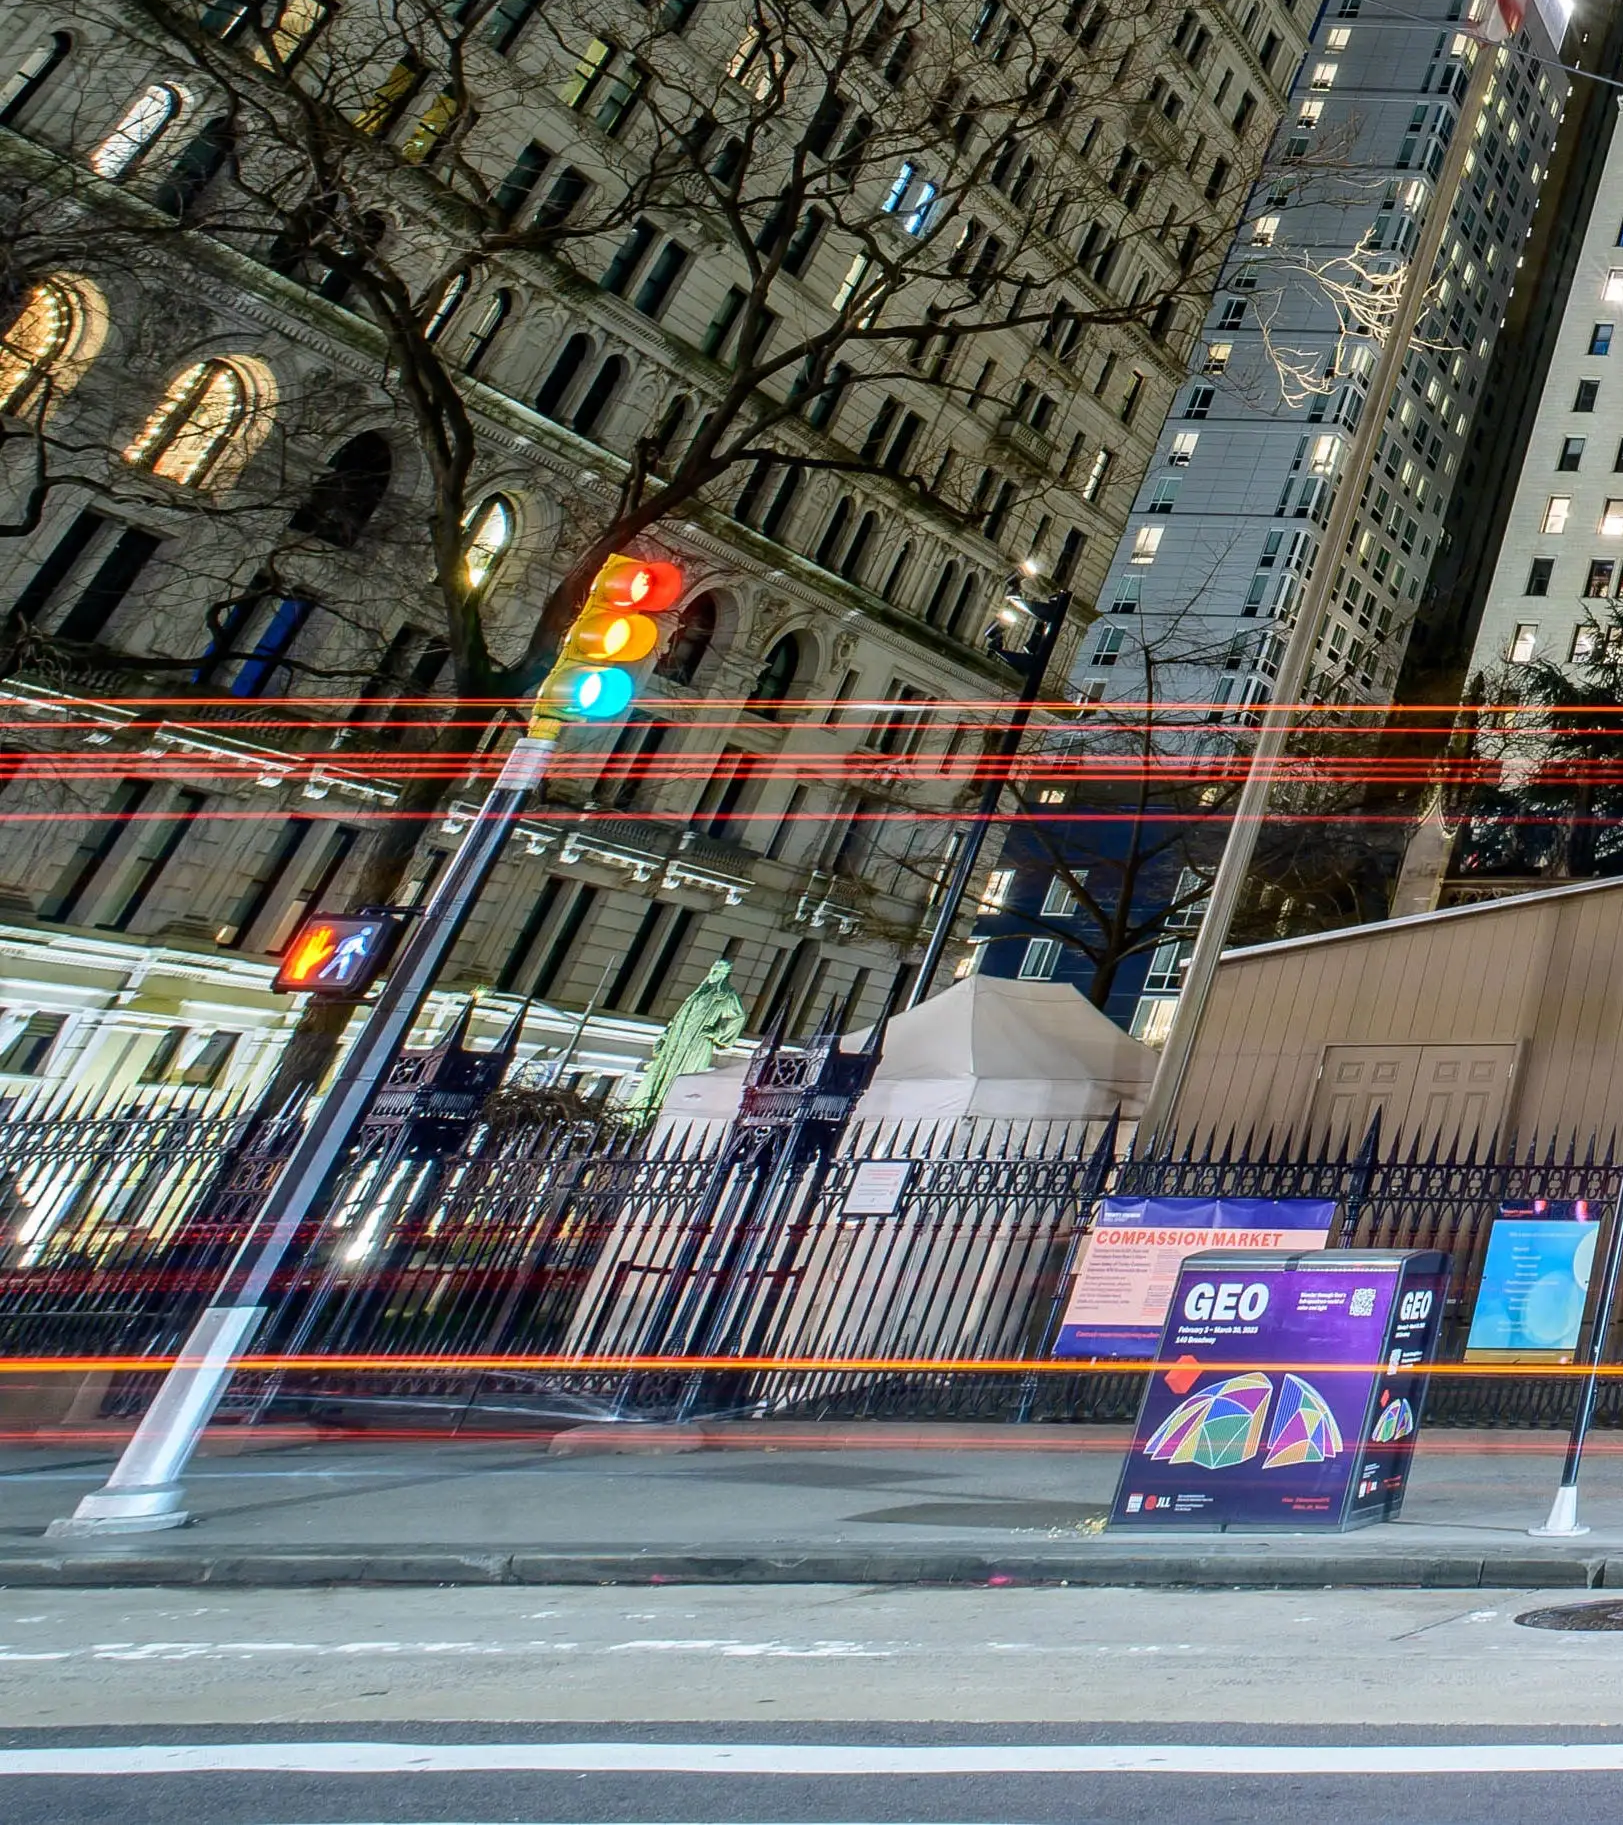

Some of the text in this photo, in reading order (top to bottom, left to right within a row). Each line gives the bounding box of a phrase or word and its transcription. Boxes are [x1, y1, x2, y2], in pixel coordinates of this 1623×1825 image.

[1096, 1230, 1283, 1248] COMPASSION MARKET
[1184, 1282, 1270, 1321] GEO
[1400, 1290, 1433, 1322] GEO
[1178, 1325, 1203, 1335] February
[1214, 1326, 1233, 1334] March
[1188, 1336, 1217, 1346] Broadway
[1156, 1496, 1171, 1508] JLL
